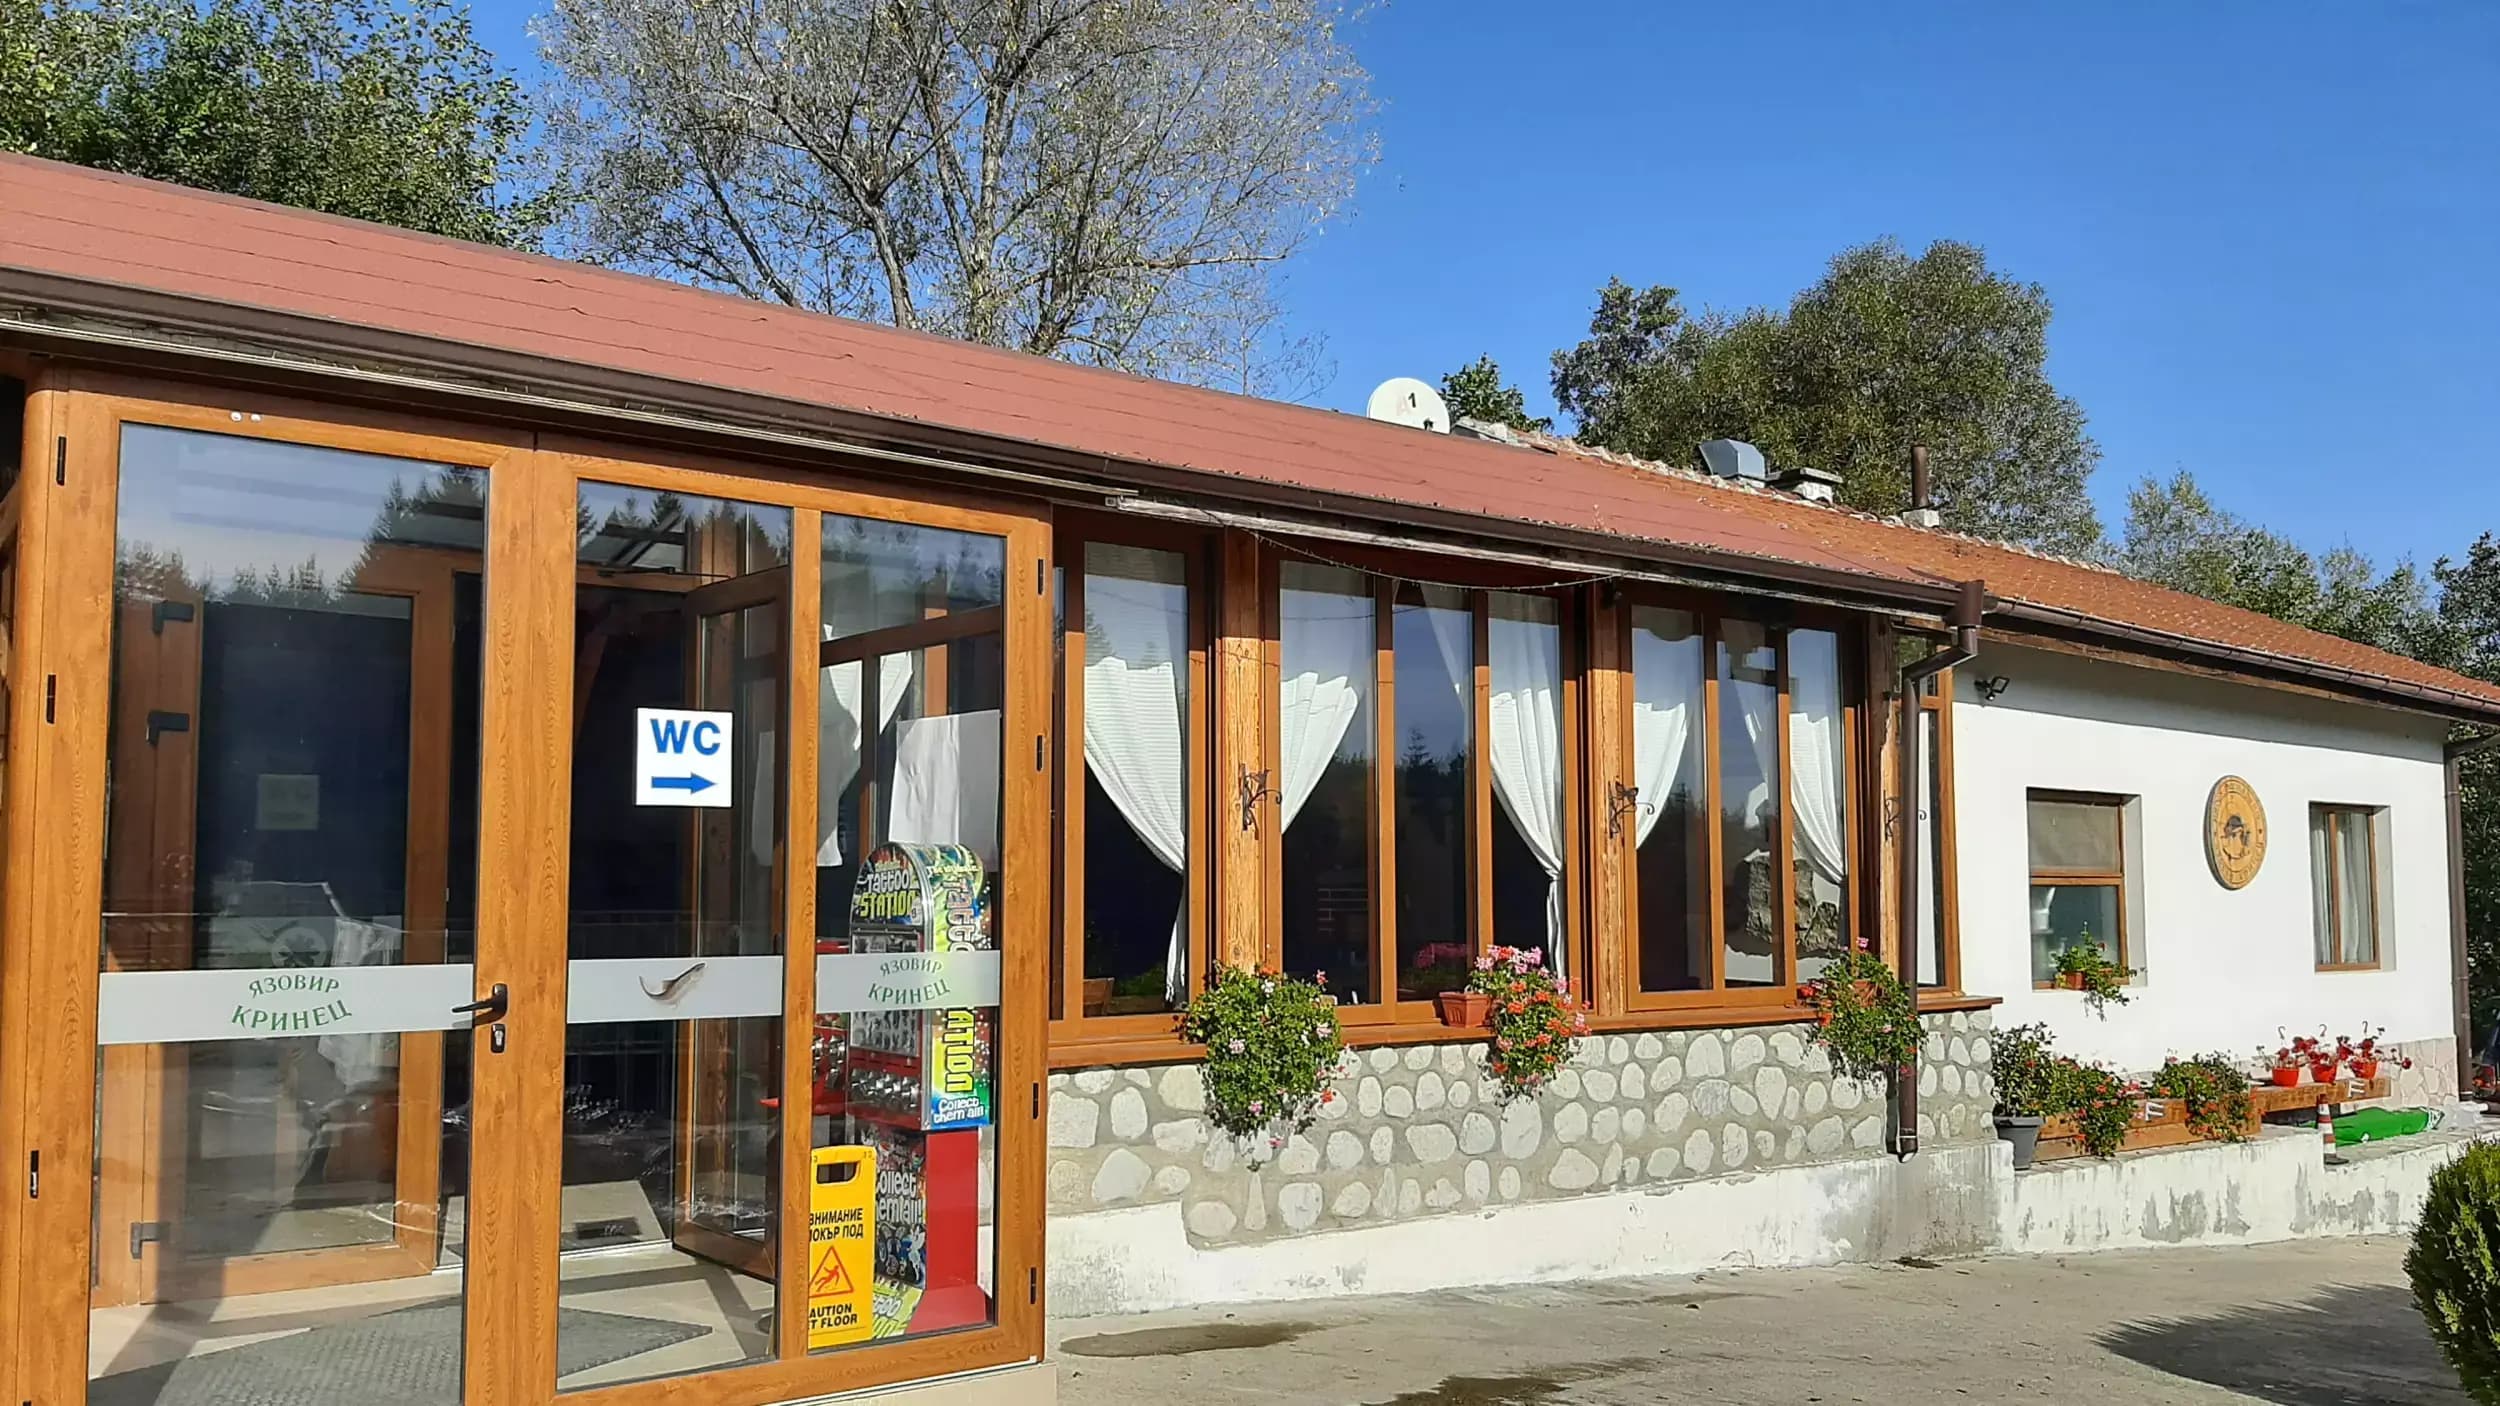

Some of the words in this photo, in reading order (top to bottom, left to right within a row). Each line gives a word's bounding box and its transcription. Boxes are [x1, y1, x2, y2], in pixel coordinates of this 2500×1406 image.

[650, 718, 721, 756] WC
[880, 958, 942, 976] ЯЗОВИР
[249, 975, 339, 998] ЯЗОВИР
[868, 979, 951, 1004] КРИНЕЦ
[232, 1000, 352, 1030] КРИНЕЦ
[842, 1223, 864, 1239] ПОД
[809, 1303, 852, 1318] AUTION
[820, 1313, 858, 1328] FLOOR
